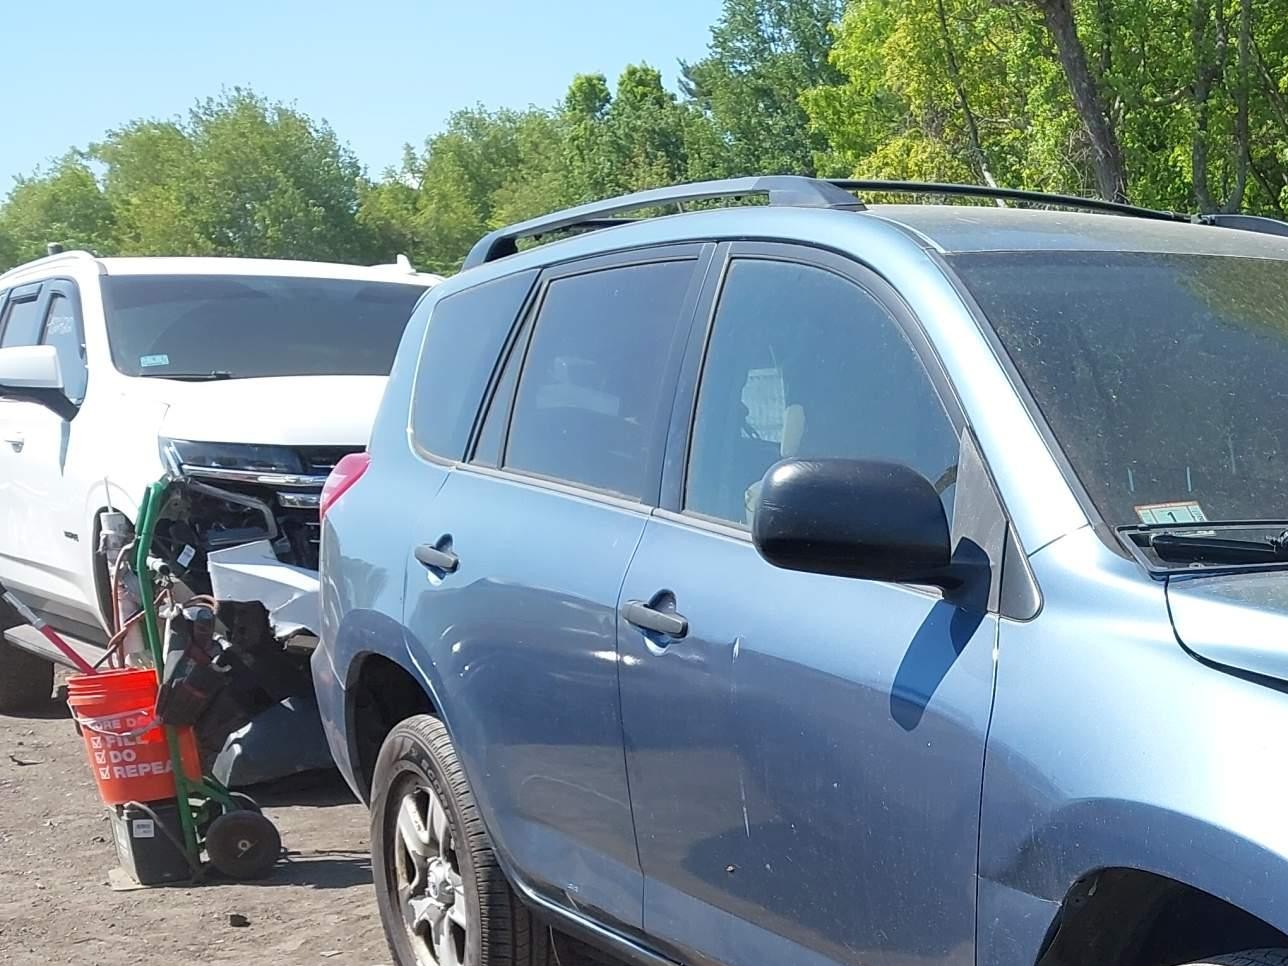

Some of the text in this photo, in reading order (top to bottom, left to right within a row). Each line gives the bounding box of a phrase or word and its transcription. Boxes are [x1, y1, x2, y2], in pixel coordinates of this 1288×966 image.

[105, 735, 149, 747] FILL
[109, 749, 136, 762] DO
[113, 760, 172, 778] REPEA
